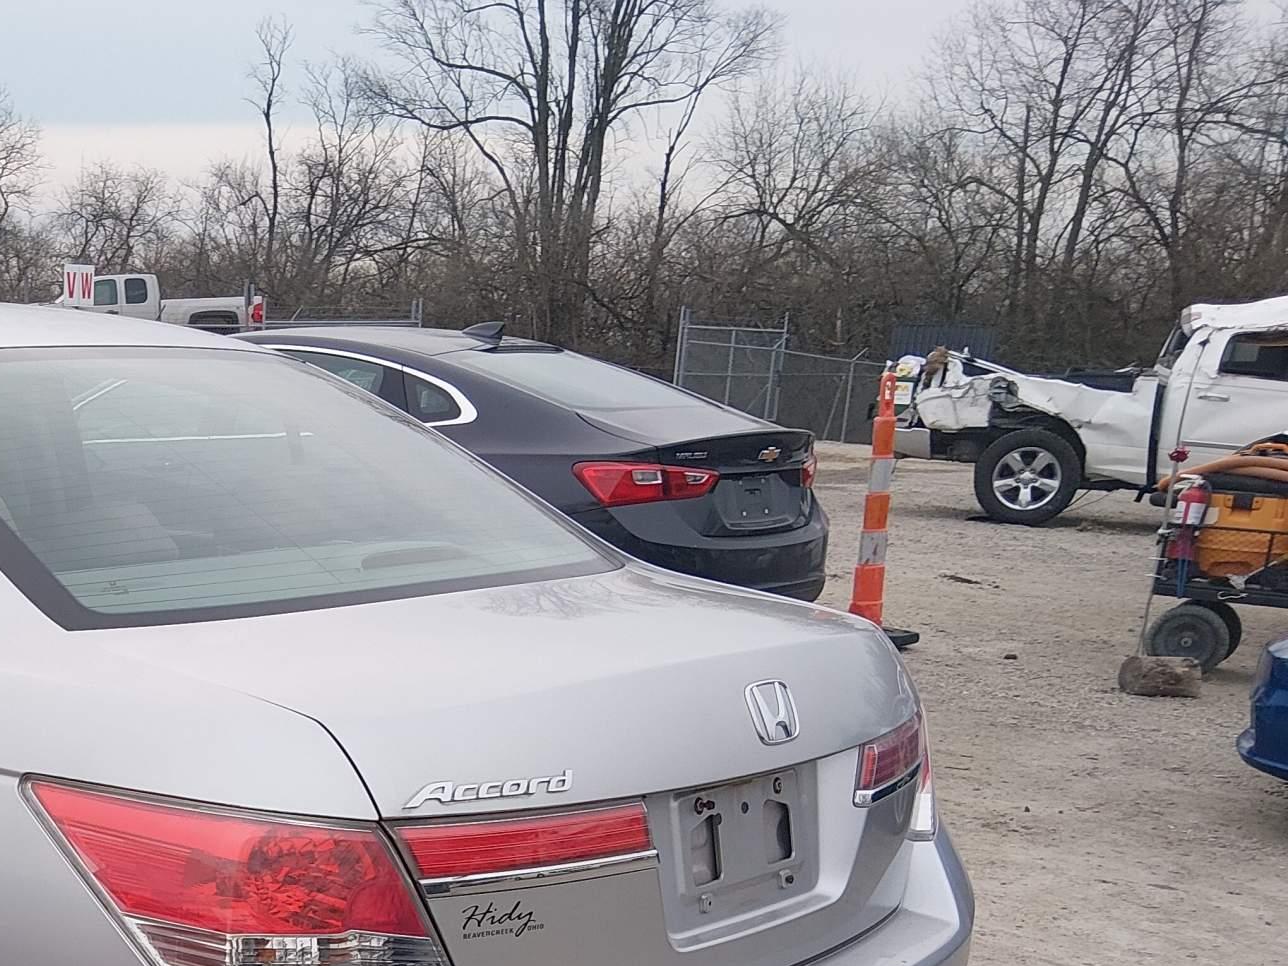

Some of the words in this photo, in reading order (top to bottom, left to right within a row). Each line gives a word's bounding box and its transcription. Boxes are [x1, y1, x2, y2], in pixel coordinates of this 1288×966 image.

[401, 769, 573, 809] Accord
[462, 900, 536, 938] Hidy
[462, 927, 515, 940] BEAVERCREEK
[527, 923, 545, 932] OHIO
